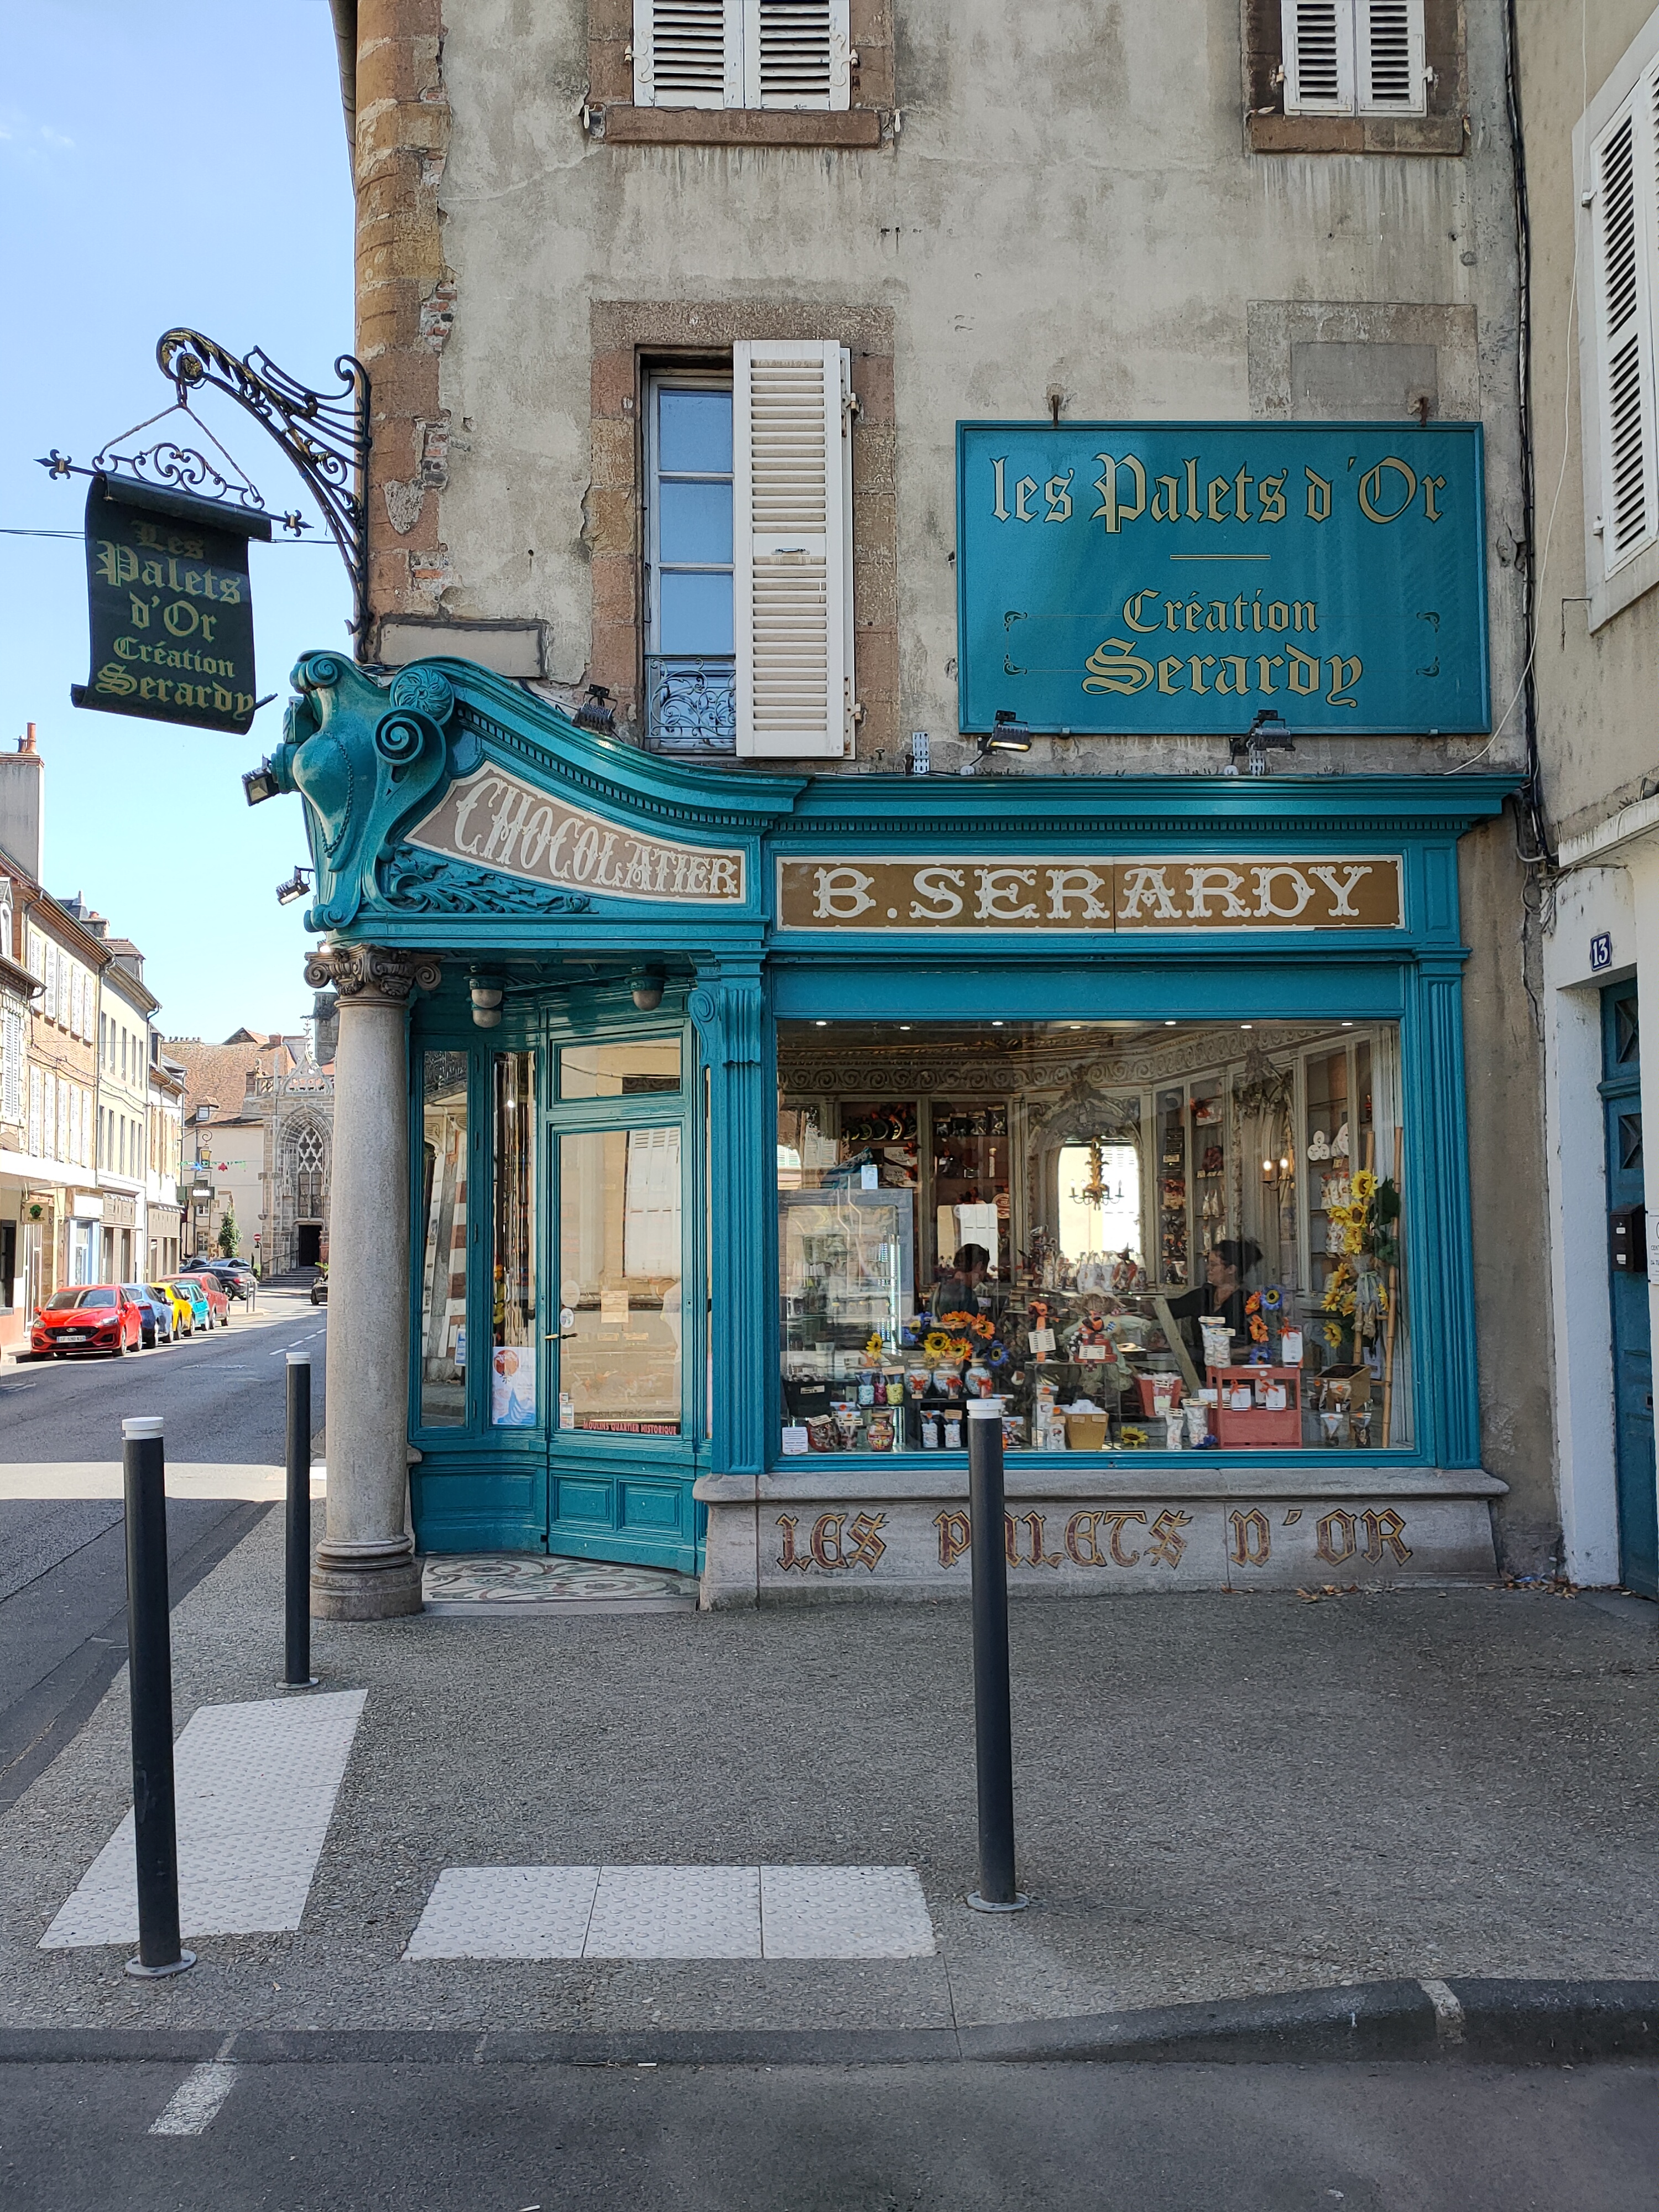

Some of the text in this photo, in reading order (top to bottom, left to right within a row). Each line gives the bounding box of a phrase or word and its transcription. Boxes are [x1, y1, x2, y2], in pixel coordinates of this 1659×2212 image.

[1088, 452, 1288, 534] Palets
[131, 519, 204, 560] Les
[96, 540, 241, 604] Palets
[129, 590, 217, 643] d'Or
[1122, 588, 1319, 633] Création
[113, 637, 235, 677] Création
[1082, 637, 1363, 707] Serardy
[95, 662, 255, 721] Serardy
[455, 778, 738, 894] CHOCOLATIER
[1593, 938, 1608, 966] 13
[583, 1421, 609, 1431] MOULINS
[611, 1422, 639, 1433] QUARTIER
[641, 1424, 677, 1436] HISTORIQUE
[776, 1512, 888, 1572] LES
[1228, 1508, 1413, 1566] D'OR
